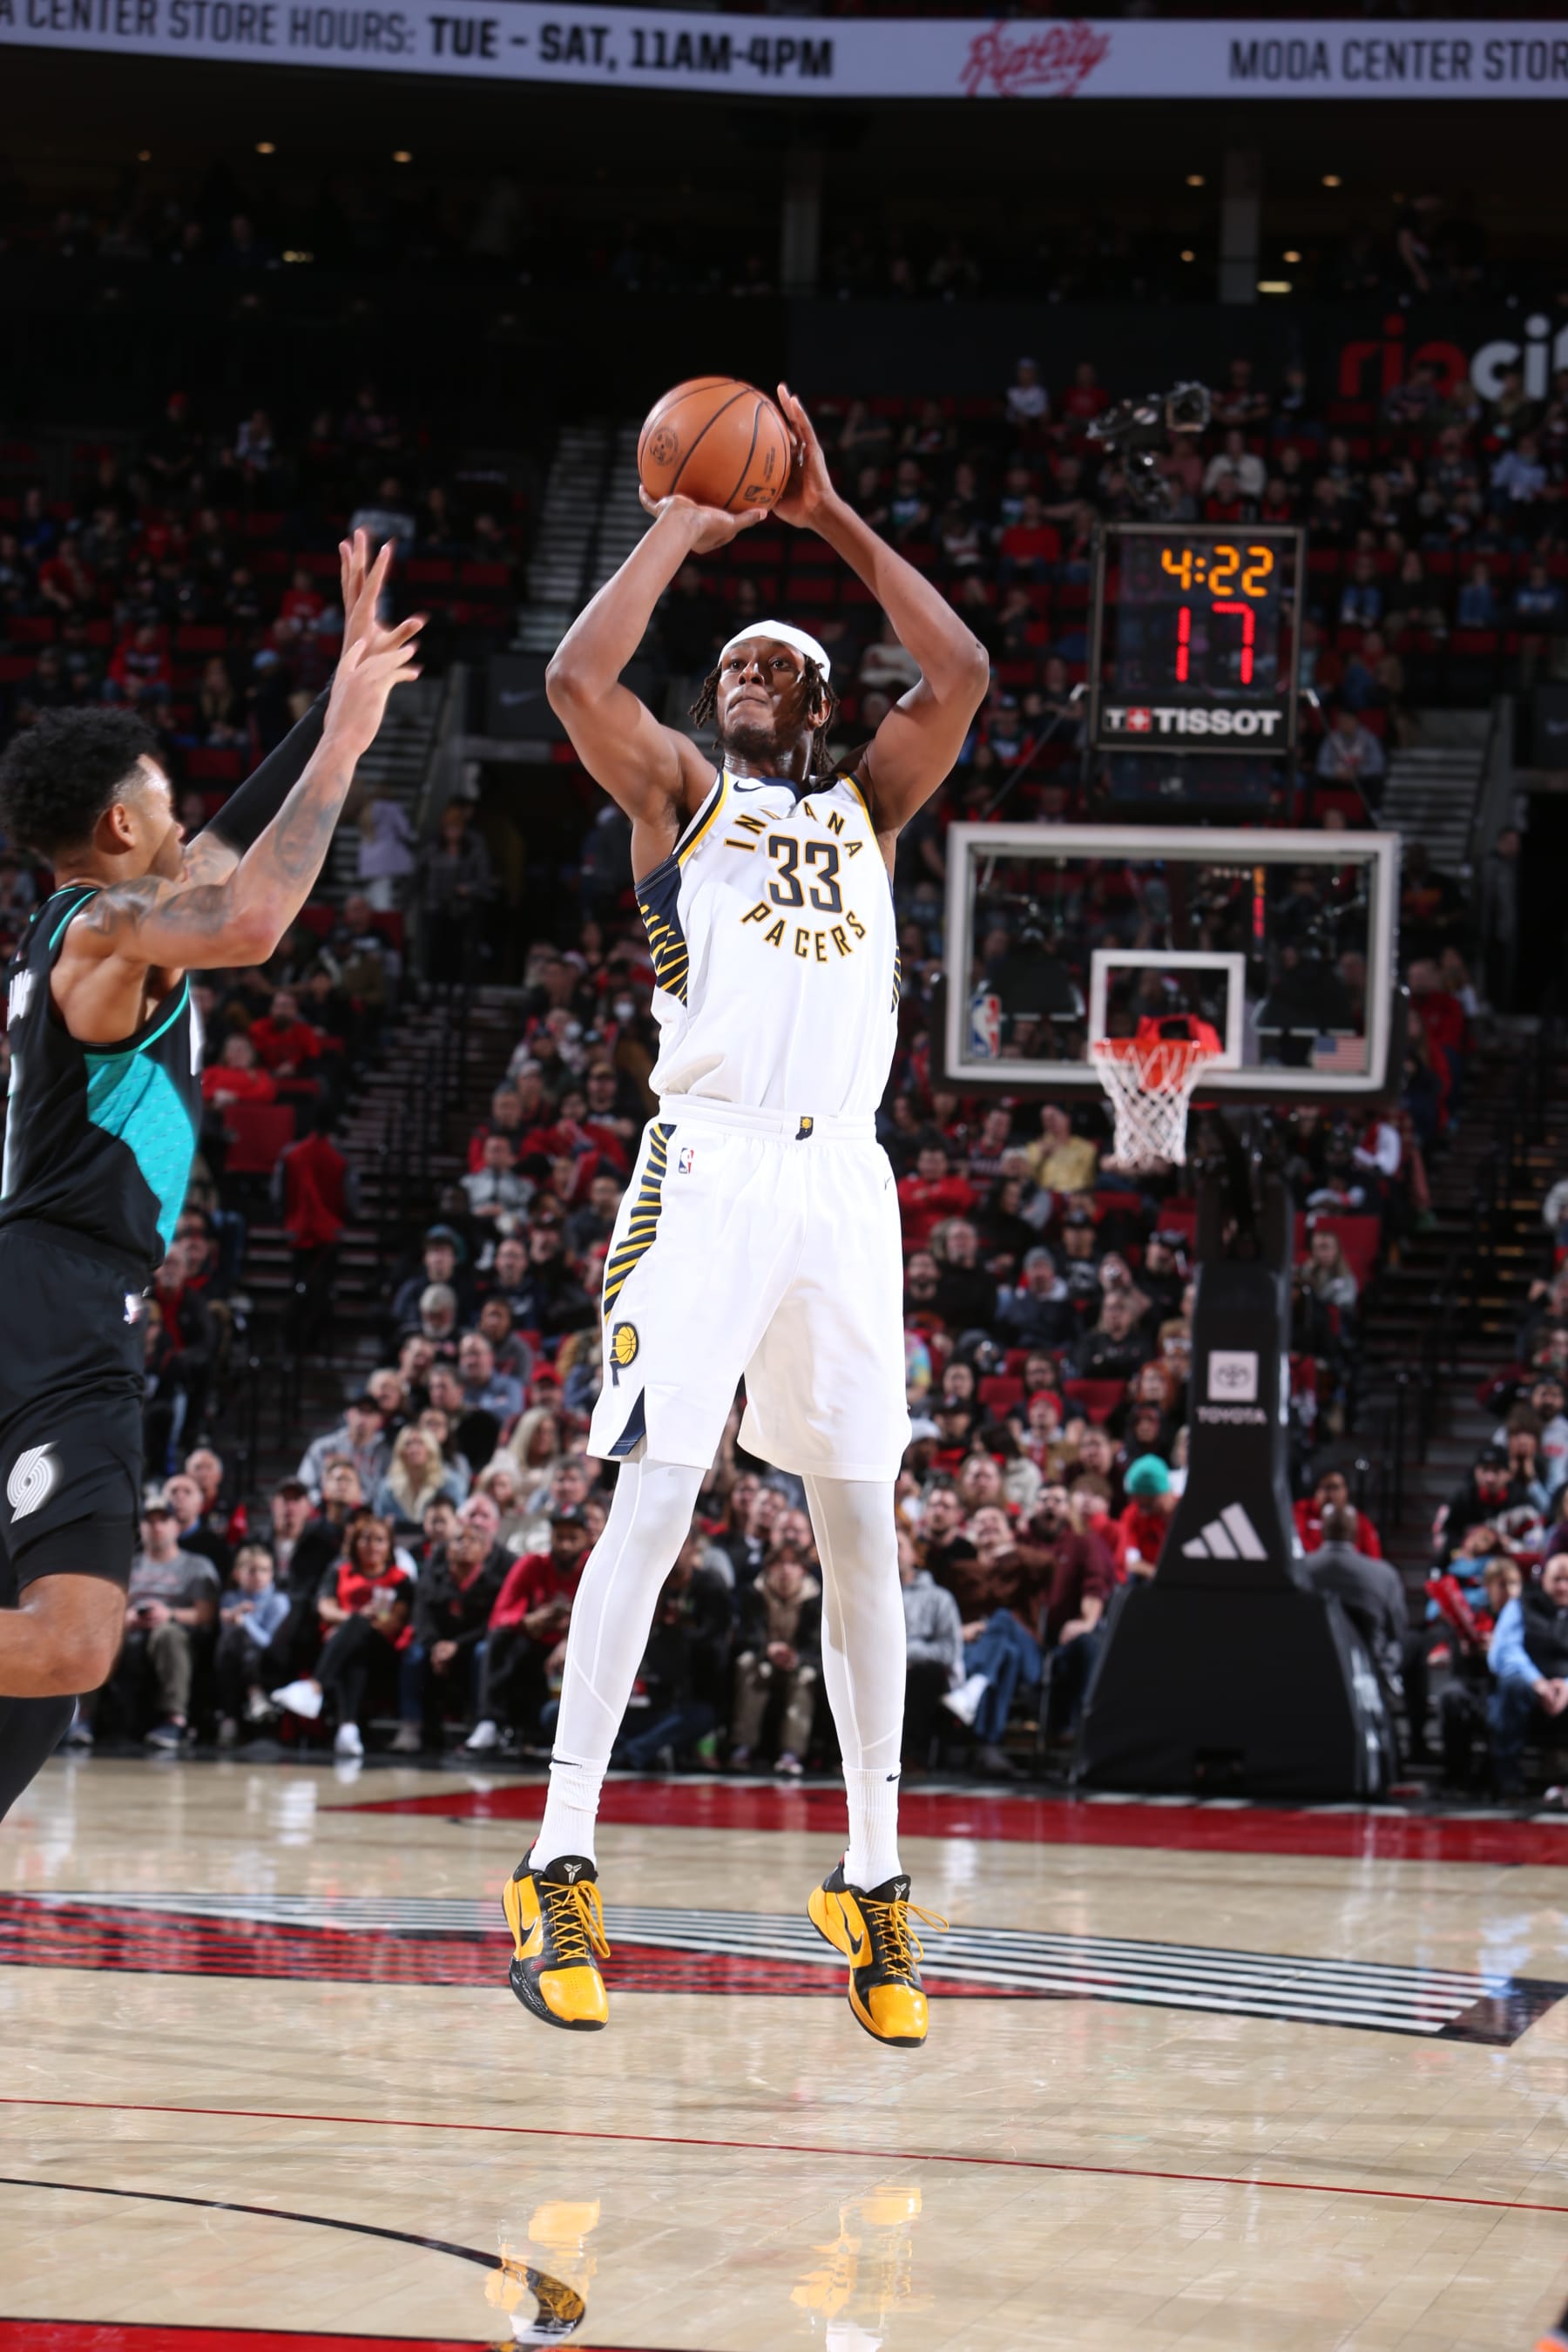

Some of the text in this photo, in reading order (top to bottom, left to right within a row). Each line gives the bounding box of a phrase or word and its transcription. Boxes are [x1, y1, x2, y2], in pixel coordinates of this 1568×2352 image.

[25, 0, 159, 37] CENTER
[169, 1, 277, 46] STORE
[289, 7, 416, 55] HOURS:
[429, 16, 498, 59] TUE
[540, 24, 617, 72] SAT,
[630, 29, 833, 78] 11AM-4PM
[1229, 39, 1332, 81] MODA
[1342, 40, 1474, 82] CENTER
[1161, 544, 1274, 598] 4:22
[1176, 601, 1255, 686] 17
[1152, 707, 1281, 735] TISSOT
[724, 801, 864, 858] INANA
[767, 834, 842, 914] 33
[740, 900, 866, 963] PACERS
[1197, 1406, 1267, 1424] TOYOTA
